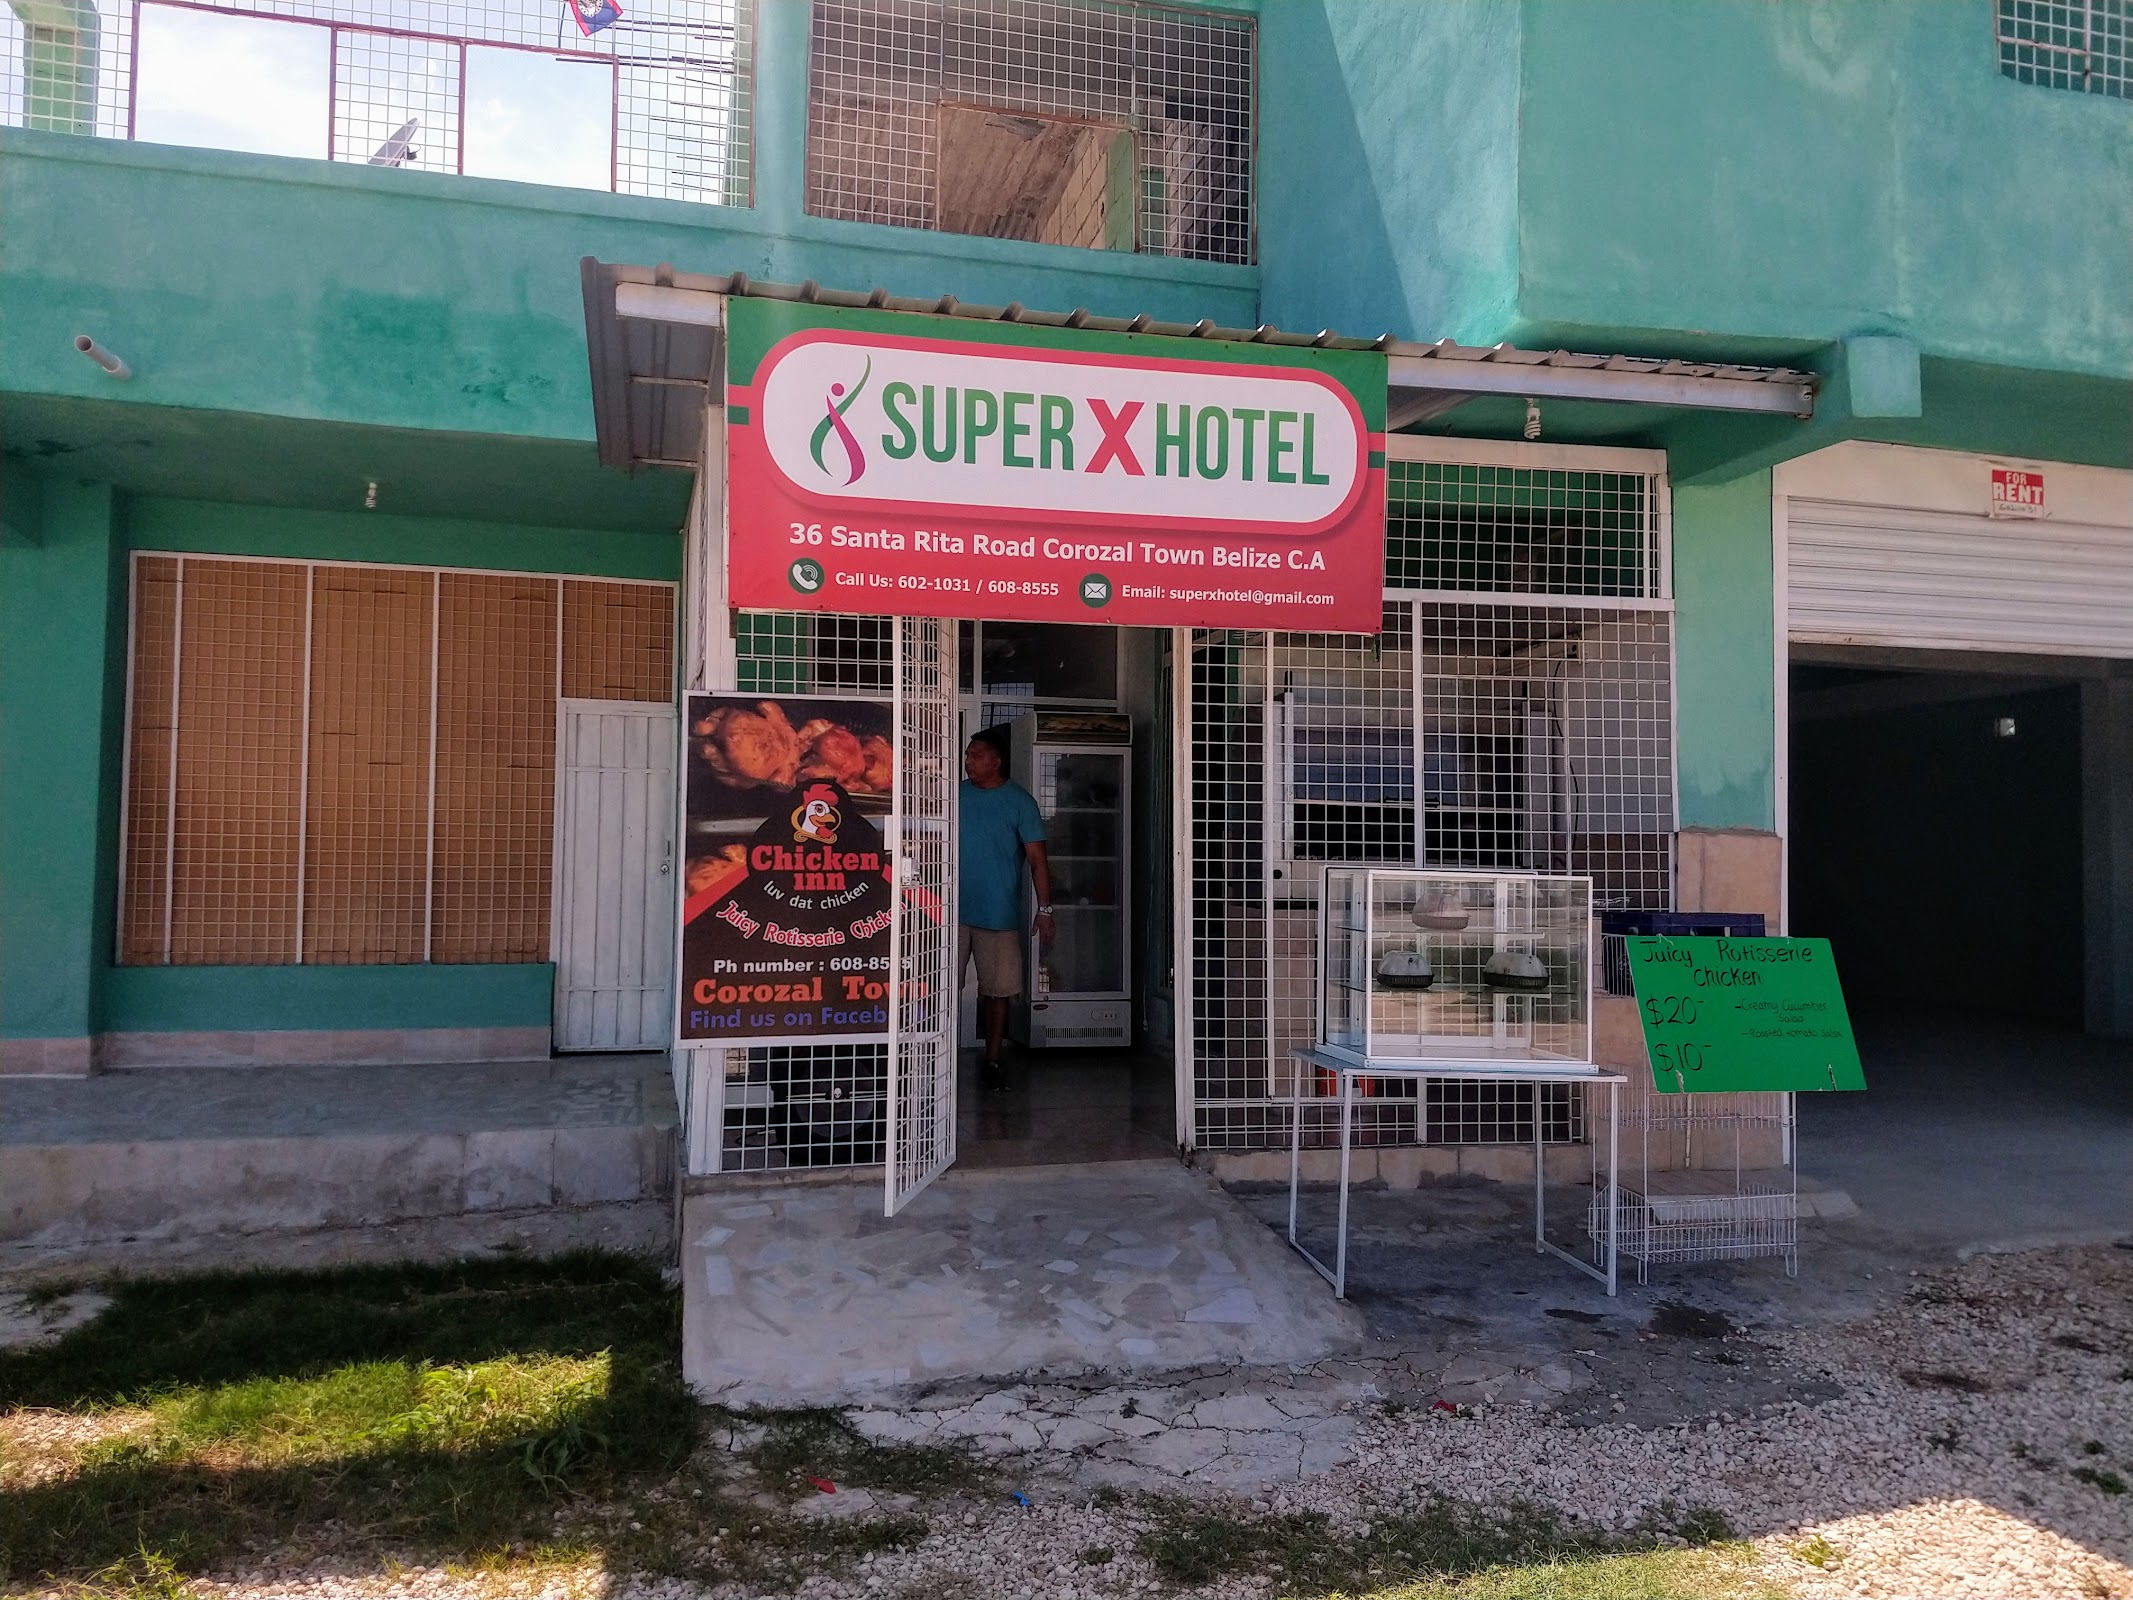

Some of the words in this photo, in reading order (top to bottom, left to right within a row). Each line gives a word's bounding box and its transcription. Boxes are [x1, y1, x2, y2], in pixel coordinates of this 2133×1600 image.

[882, 381, 1075, 472] SUPER
[1084, 398, 1145, 477] X
[1154, 403, 1330, 486] HOTEL
[2006, 472, 2027, 485] FOR
[1993, 482, 2042, 504] RENT
[789, 522, 823, 546] 36
[830, 525, 906, 551] Santa
[914, 531, 964, 554] Rita
[973, 534, 1035, 558] Road
[1043, 537, 1132, 563] Corozal
[1139, 543, 1204, 566] Town
[1212, 546, 1282, 569] Belize
[1287, 550, 1326, 571] C.A
[835, 571, 864, 586] Call
[869, 573, 893, 588] Us:
[898, 575, 970, 592] 602-1031
[976, 580, 983, 594] /
[988, 580, 1059, 596] 608-8555
[1122, 585, 1166, 600] Email:
[1169, 587, 1335, 606] superxhotel@gmail.com
[751, 845, 880, 871] Chicken
[794, 872, 846, 891] inn
[763, 880, 785, 901] luv
[789, 894, 813, 910] dat
[820, 881, 869, 910] chicken
[716, 900, 760, 938] Juicy
[763, 922, 845, 947] Rotisserie
[713, 959, 737, 973] Ph
[743, 957, 813, 973] number
[830, 956, 912, 971] 608-855
[1640, 939, 1693, 968] Juicy
[1717, 939, 1812, 963] Rotisserie
[693, 976, 823, 1004] Corozal
[690, 1008, 741, 1029] Find
[750, 1011, 775, 1027] us
[784, 1010, 812, 1026] on
